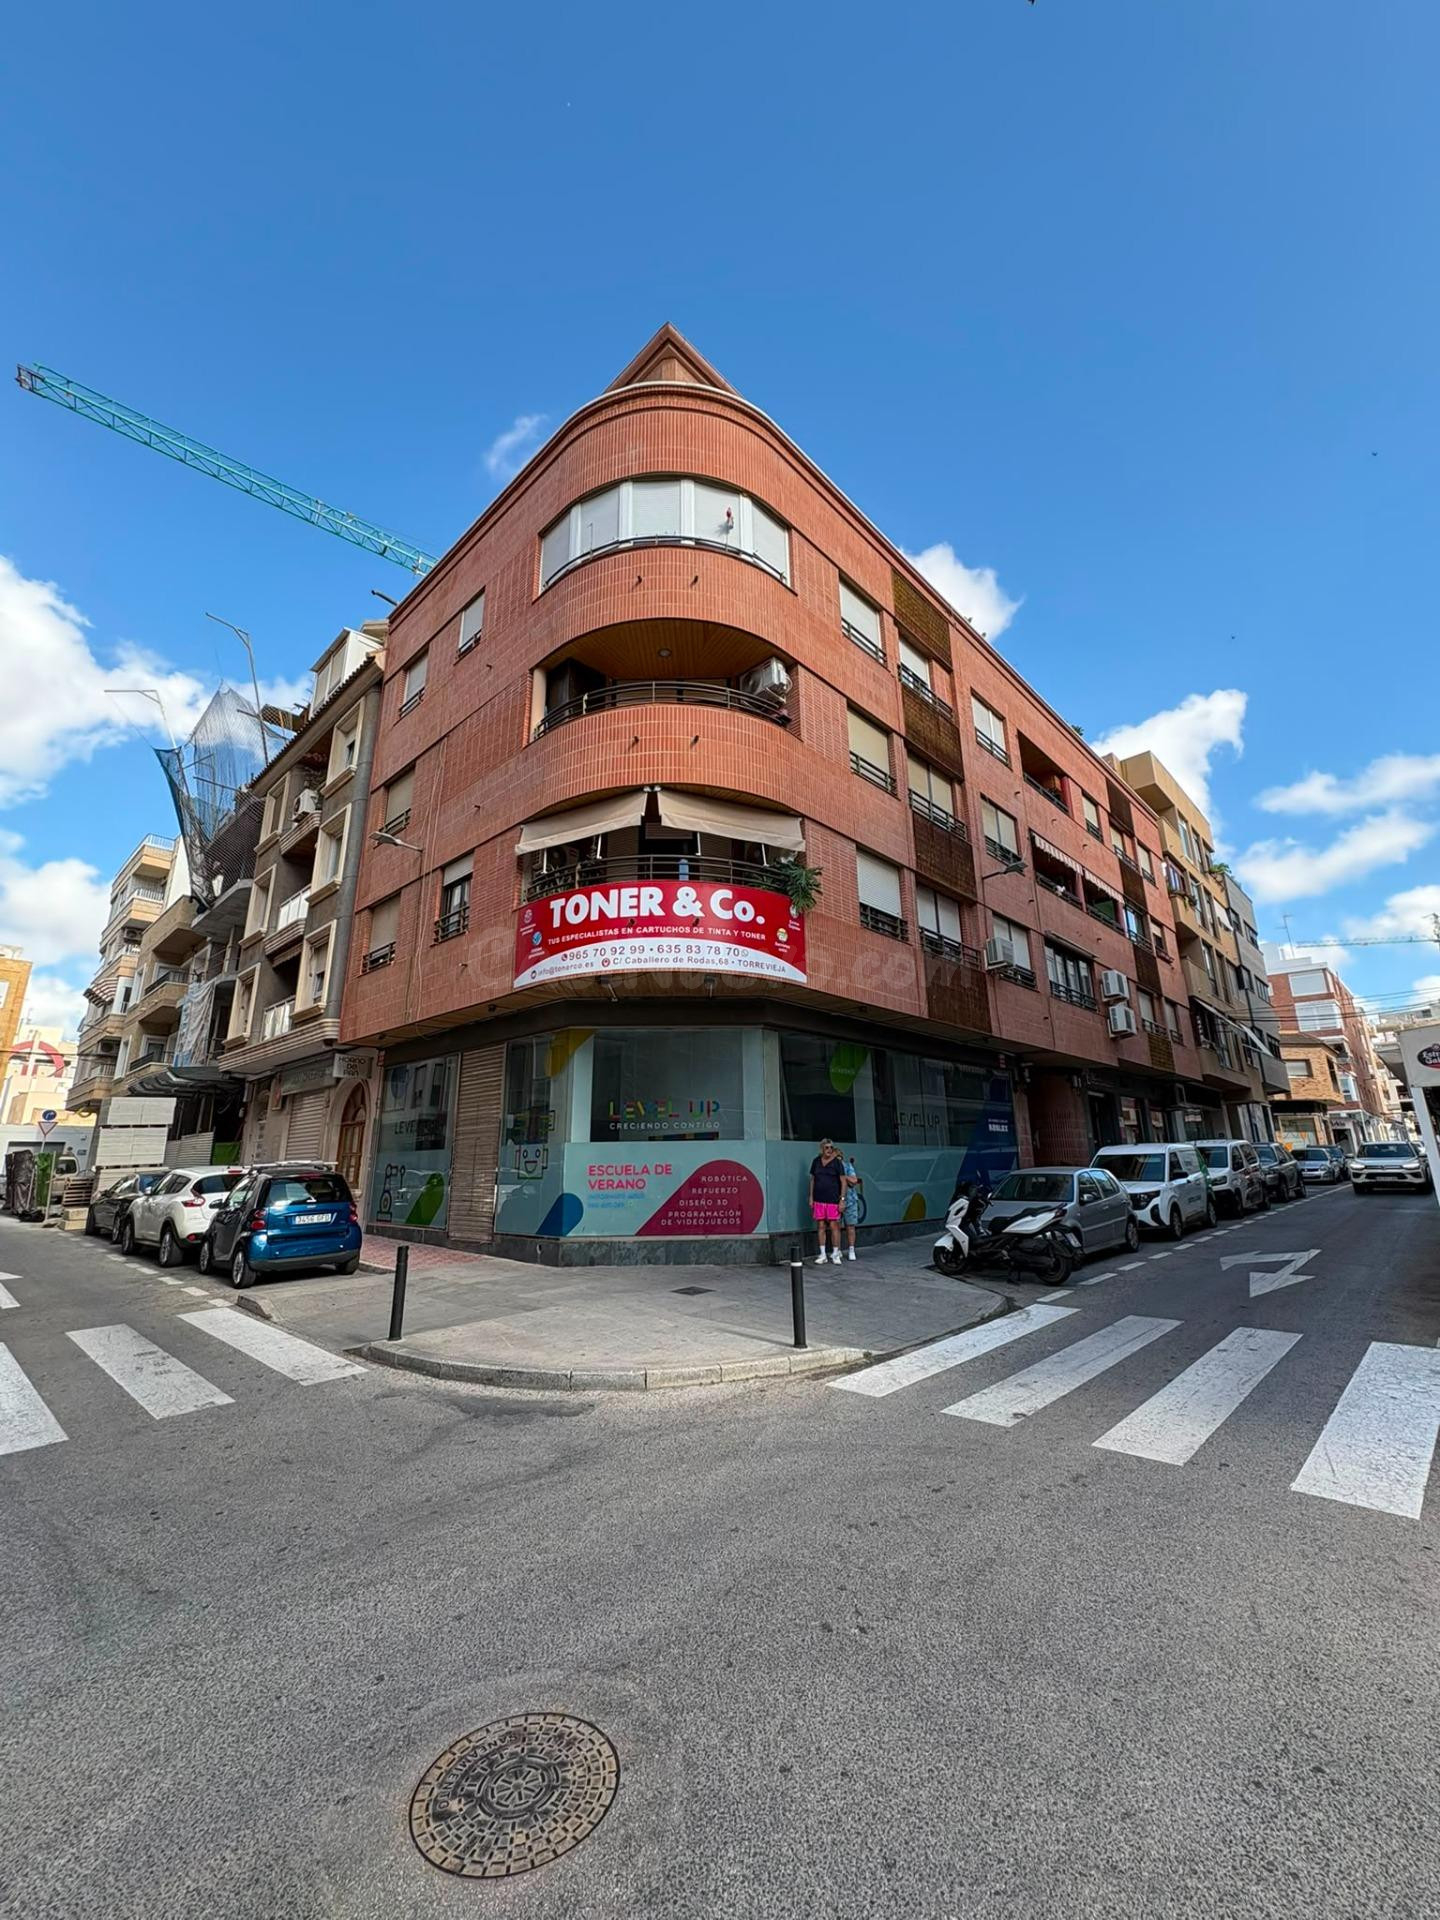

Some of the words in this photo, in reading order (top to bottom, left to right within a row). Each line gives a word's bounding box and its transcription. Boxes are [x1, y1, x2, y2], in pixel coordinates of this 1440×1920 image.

[550, 886, 665, 928] TONER
[672, 886, 705, 918] &
[710, 889, 765, 925] Co.
[562, 927, 619, 942] ESPECIALISTAS
[622, 927, 633, 935] EN
[636, 926, 690, 934] CARTUCHOS
[692, 926, 705, 934] DE
[707, 927, 732, 936] TINTA
[741, 931, 766, 940] TONER
[568, 950, 588, 961] 965
[593, 947, 606, 957] 70
[610, 946, 625, 956] 92
[630, 944, 645, 954] 99
[657, 944, 681, 954] 635
[686, 944, 701, 954] 83
[707, 945, 721, 955] 78
[726, 947, 740, 957] 70
[625, 955, 670, 965] Caballero
[738, 959, 786, 973] TORREVIEJA
[609, 1100, 680, 1120] LEVEL
[689, 1100, 720, 1118] UP
[609, 1122, 669, 1130] CRECIENDO
[673, 1121, 720, 1129] CONTIGO
[588, 1164, 650, 1176] ESCUELA
[654, 1164, 672, 1175] DE
[701, 1174, 748, 1182] ROBÓTICA
[588, 1179, 646, 1190] VERANO
[679, 1198, 712, 1207] DISEÑO
[668, 1209, 741, 1218] PROGRAMACIÓN
[676, 1217, 741, 1225] VIDEOJUEGOS
